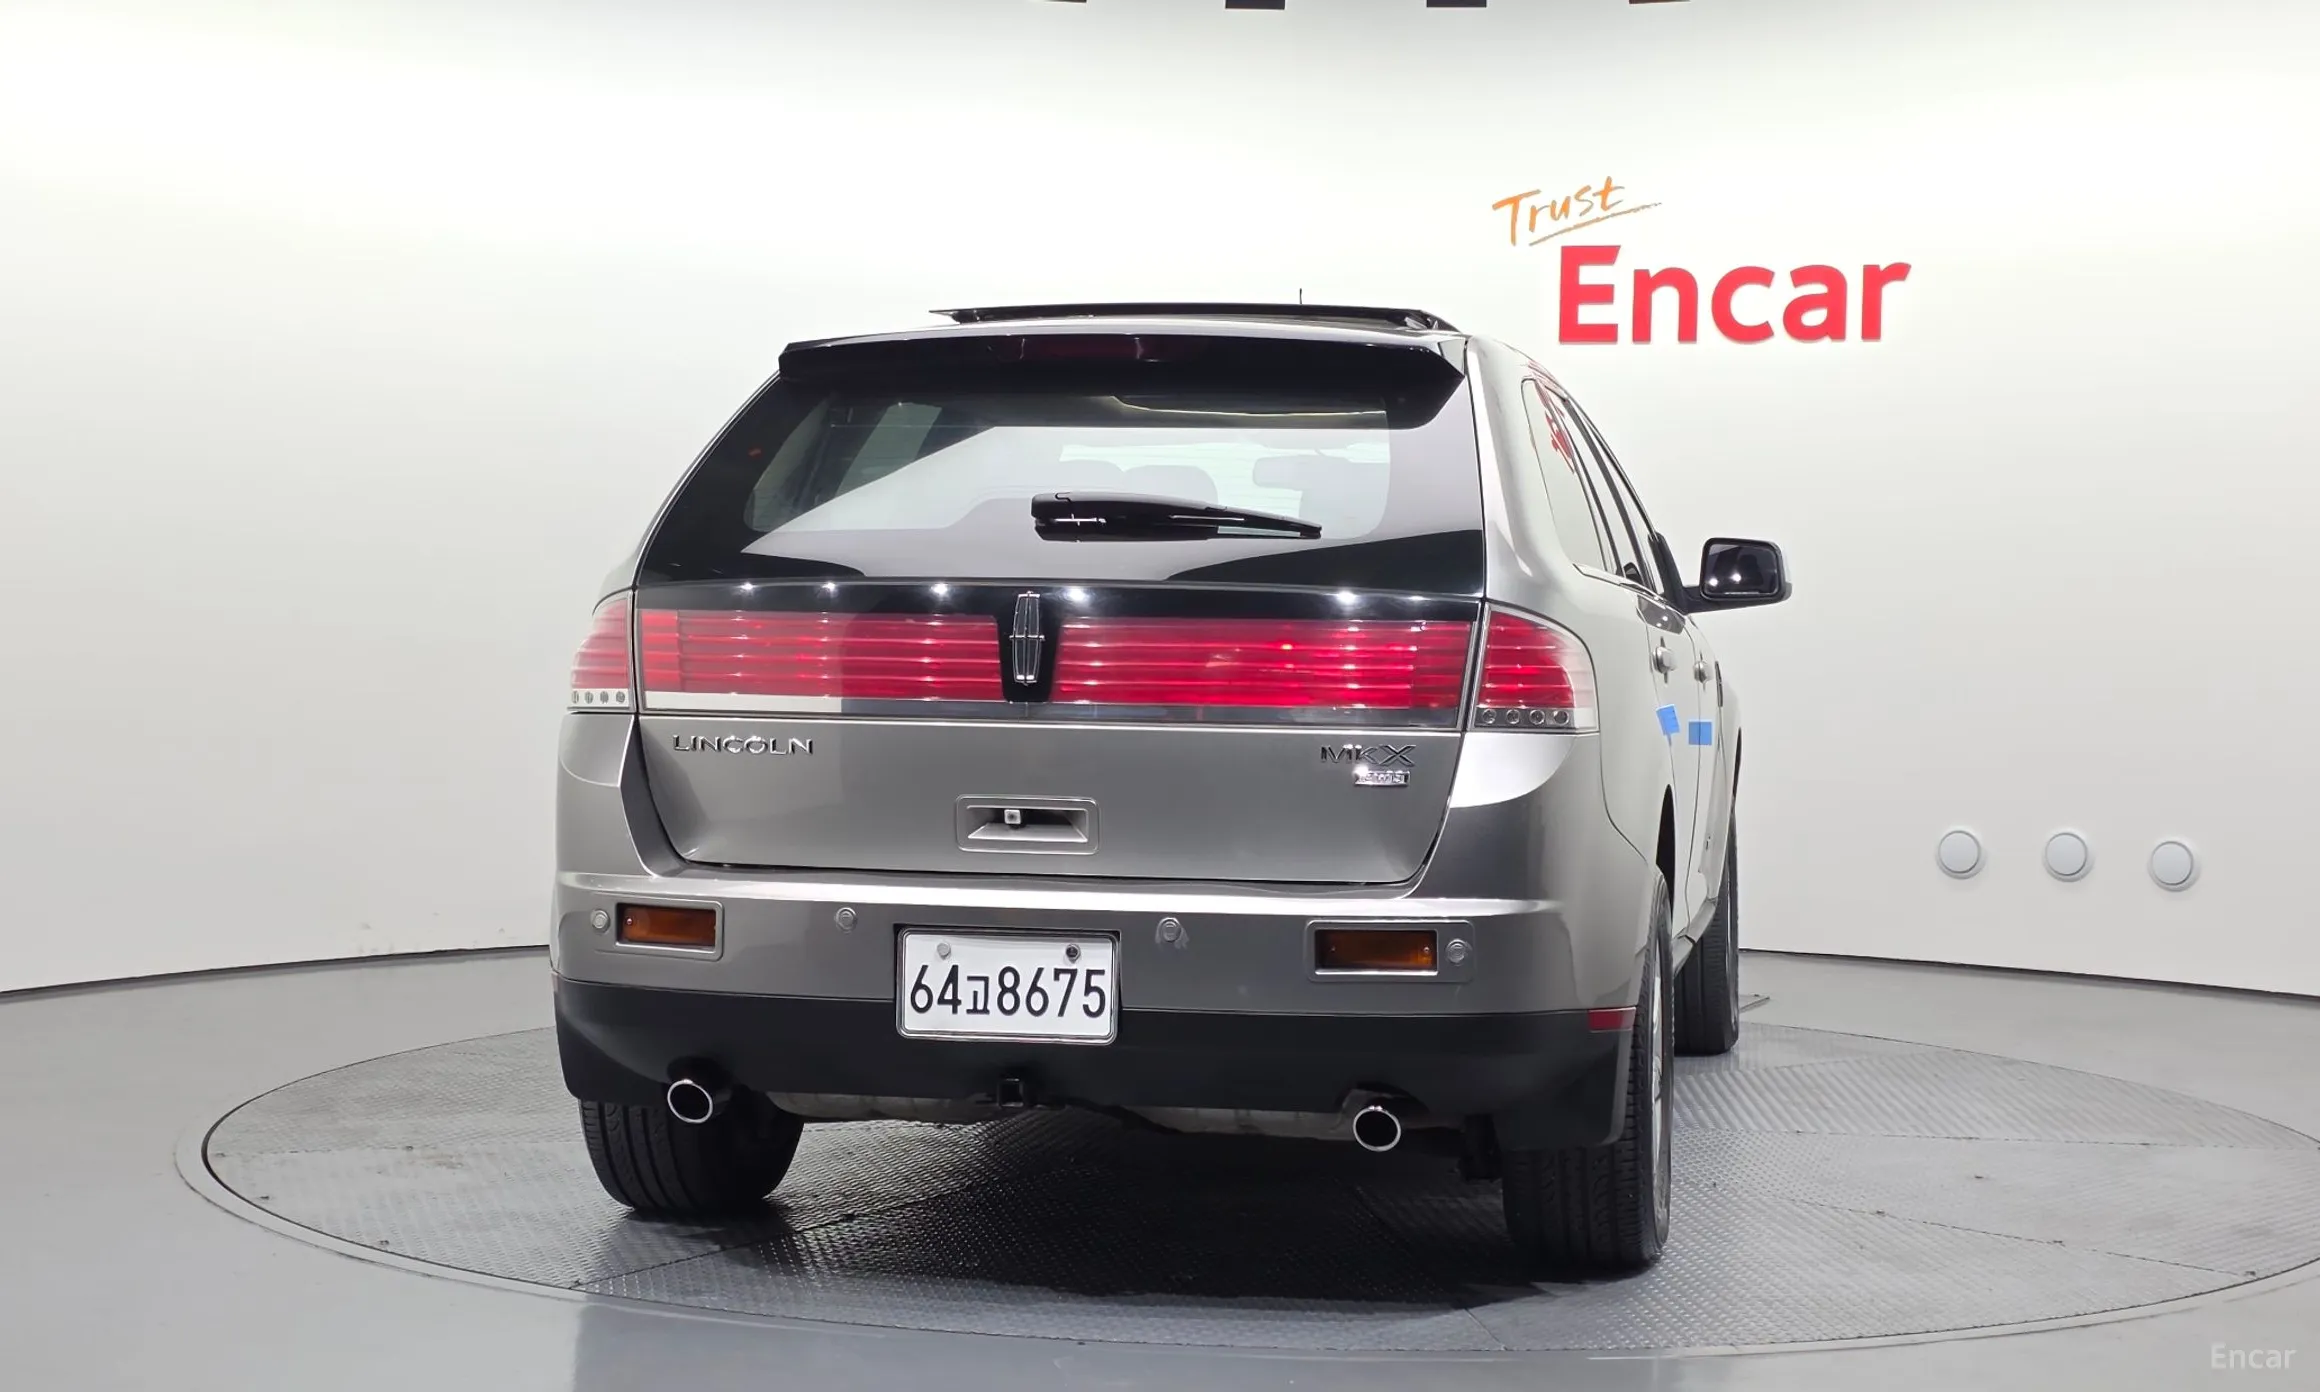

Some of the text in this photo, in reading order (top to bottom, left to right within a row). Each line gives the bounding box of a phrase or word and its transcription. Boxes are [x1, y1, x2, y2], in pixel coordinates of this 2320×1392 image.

[1492, 176, 1624, 246] Trust
[1559, 245, 1912, 343] Encar
[673, 734, 814, 755] LINCOLN
[1320, 744, 1416, 767] MKX
[910, 964, 1107, 1018] 64고8675
